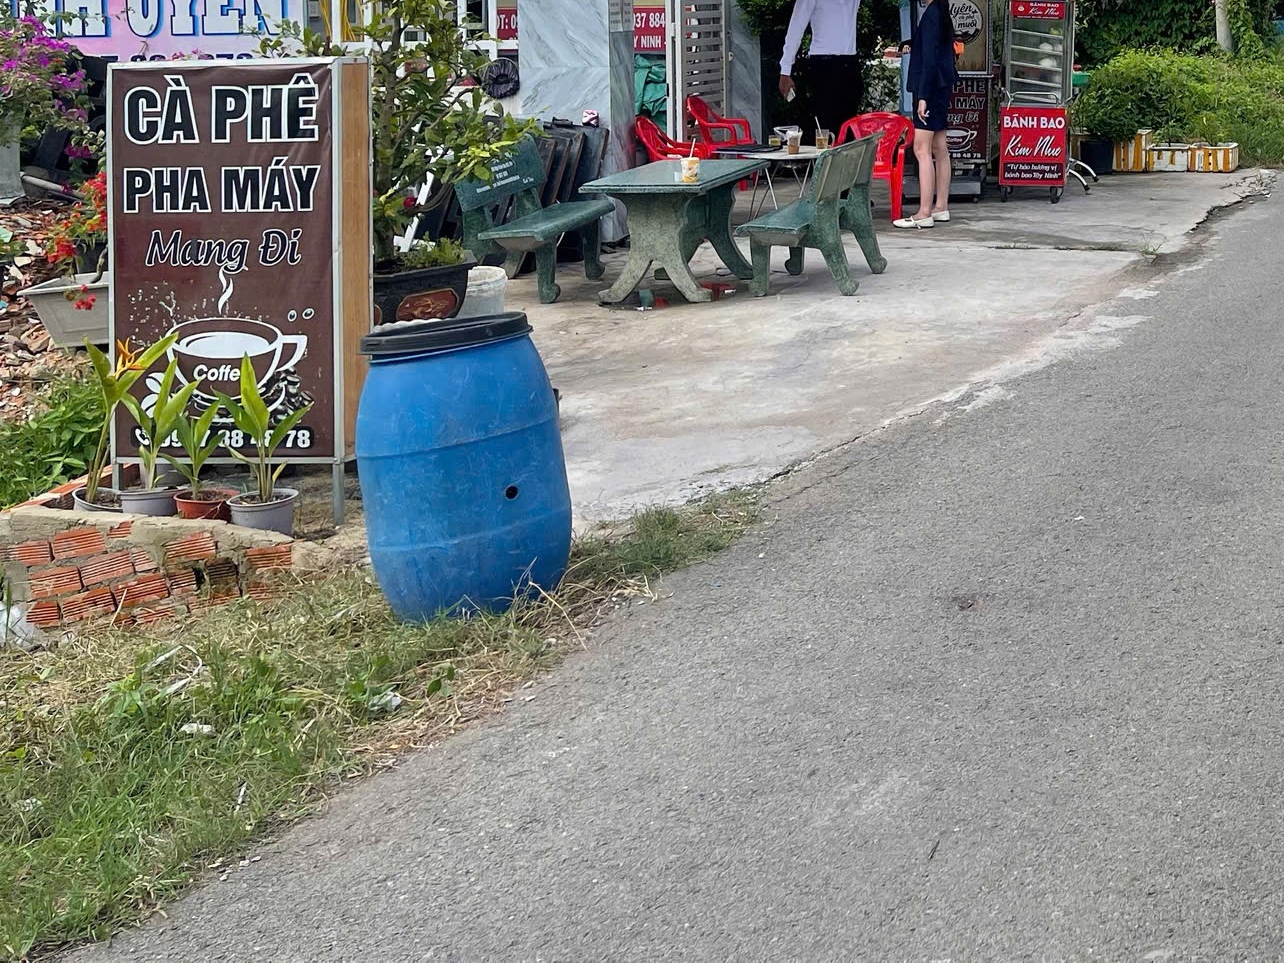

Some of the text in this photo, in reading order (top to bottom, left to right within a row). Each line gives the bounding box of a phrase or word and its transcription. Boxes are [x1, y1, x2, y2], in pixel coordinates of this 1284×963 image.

[641, 35, 662, 48] NINH
[124, 73, 319, 145] CÀ PHÊ
[955, 95, 987, 109] MÁY
[1003, 114, 1066, 129] BÁNH BAO
[1004, 134, 1032, 156] Kim
[124, 156, 321, 213] PHA MÁY
[146, 228, 302, 273] Mang Đi
[193, 364, 241, 382] Coffe
[217, 429, 244, 448] 88
[285, 429, 311, 448] 78
